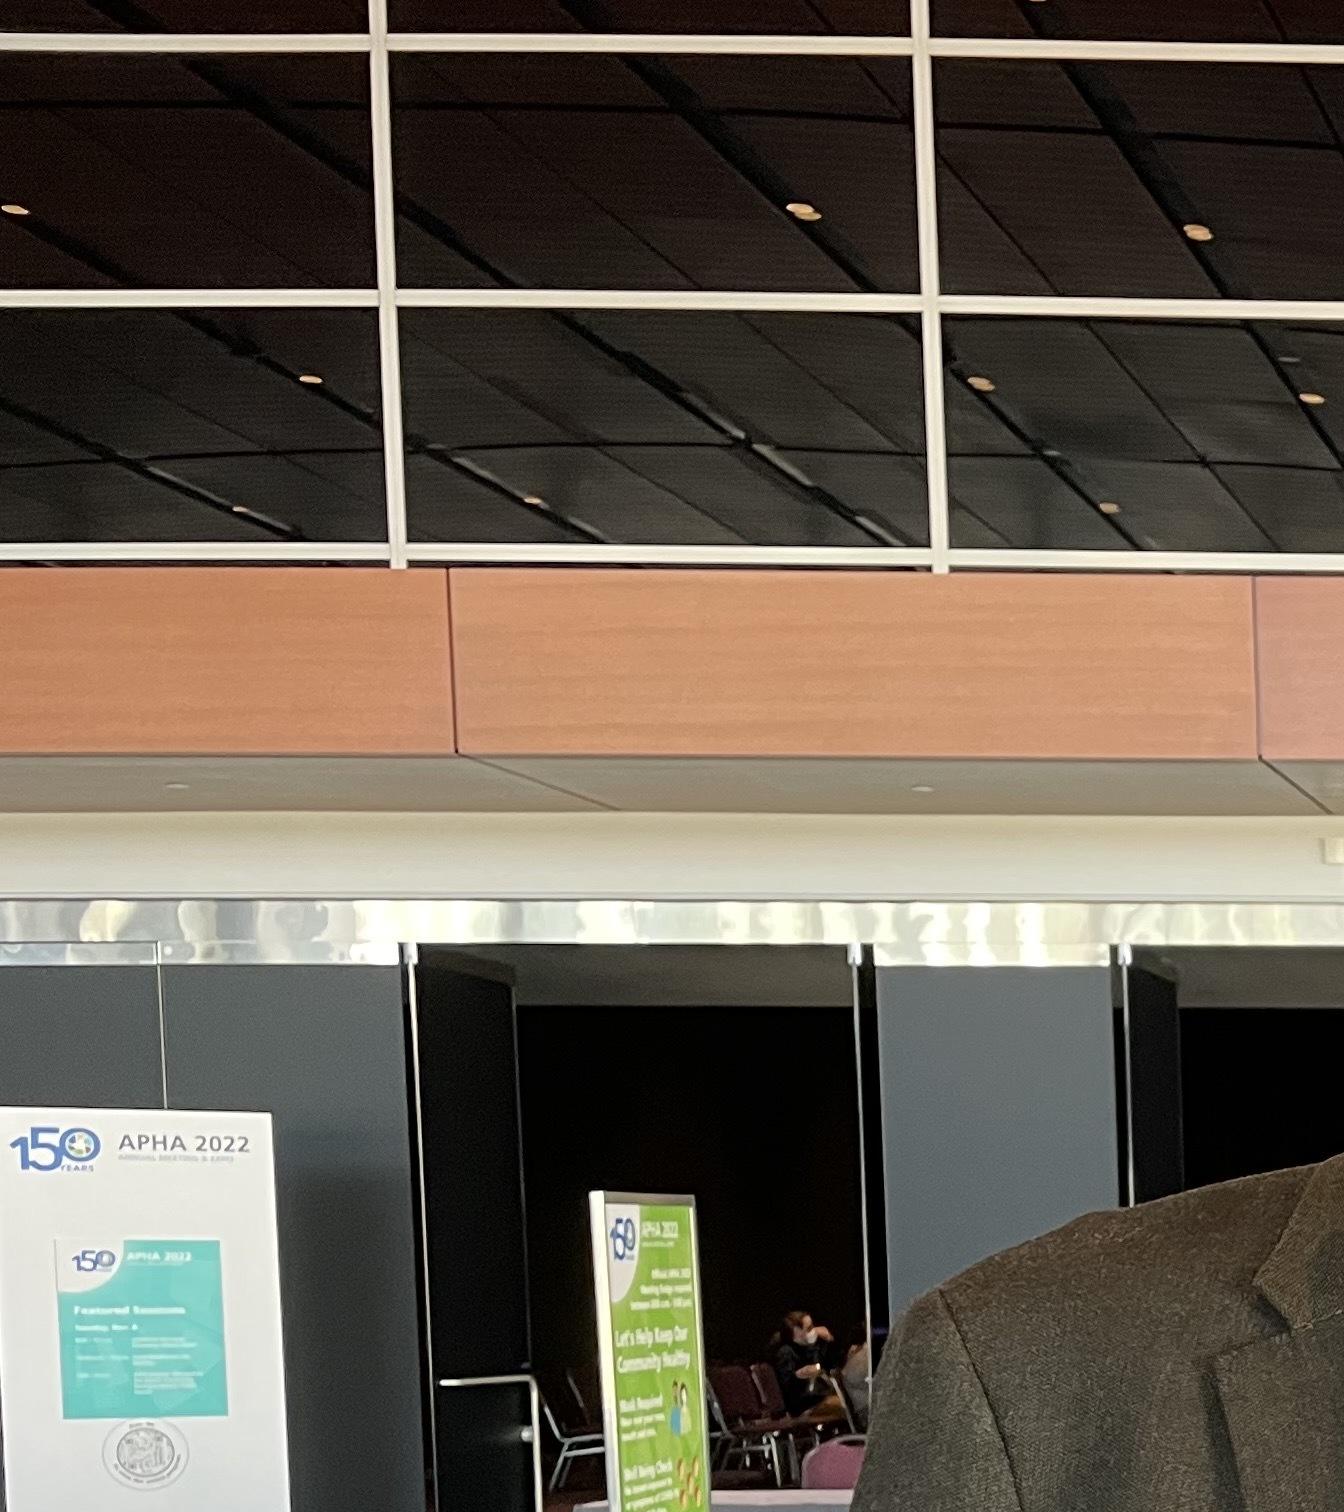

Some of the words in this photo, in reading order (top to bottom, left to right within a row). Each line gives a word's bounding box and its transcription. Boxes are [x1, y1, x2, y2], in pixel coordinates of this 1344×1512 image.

[10, 1127, 101, 1171] 150
[118, 1134, 187, 1151] APHA
[194, 1135, 250, 1152] 2022
[72, 1250, 116, 1272] 150
[126, 1251, 161, 1261] APHA
